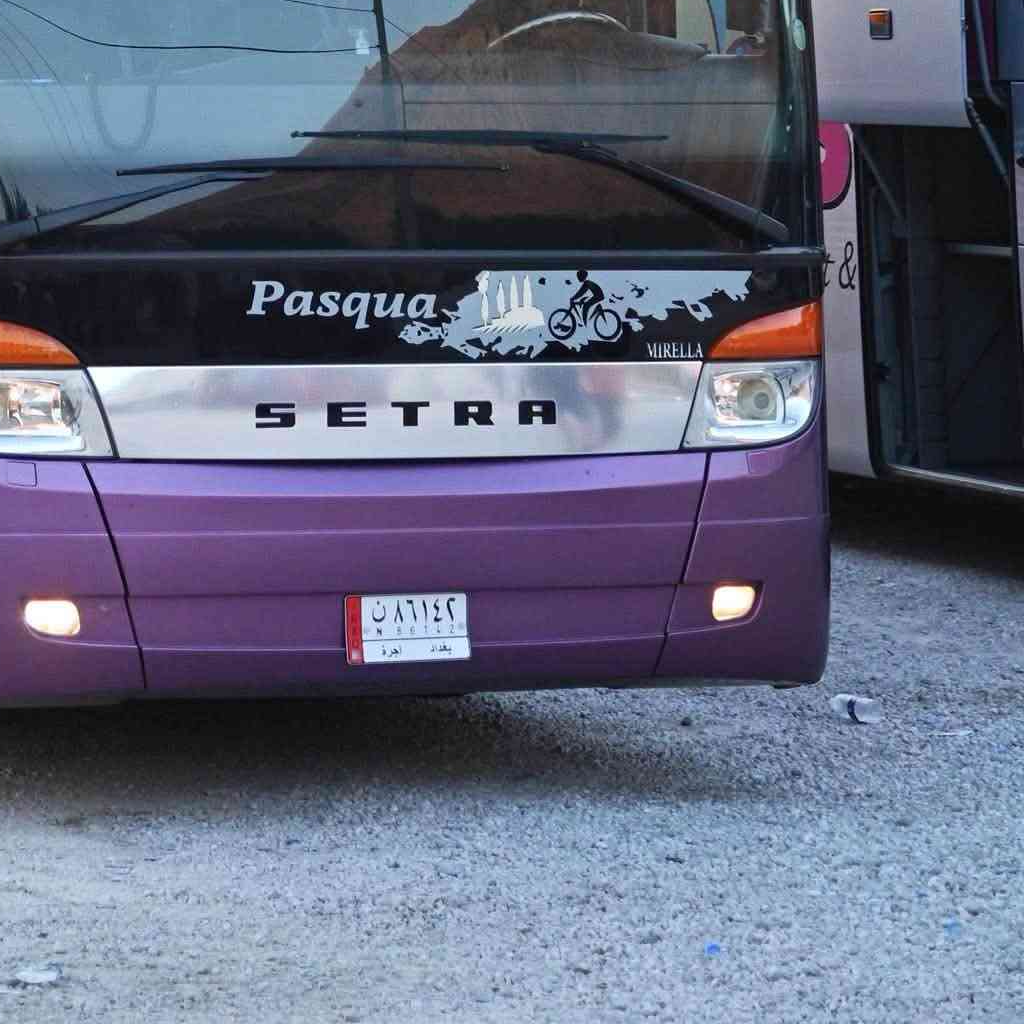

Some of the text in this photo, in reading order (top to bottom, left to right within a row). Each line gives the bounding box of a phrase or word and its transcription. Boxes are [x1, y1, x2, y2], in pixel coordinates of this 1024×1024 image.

[839, 241, 857, 291] &
[247, 280, 438, 330] Pasqua
[647, 342, 704, 358] MIRELLA
[256, 401, 557, 428] SETRA
